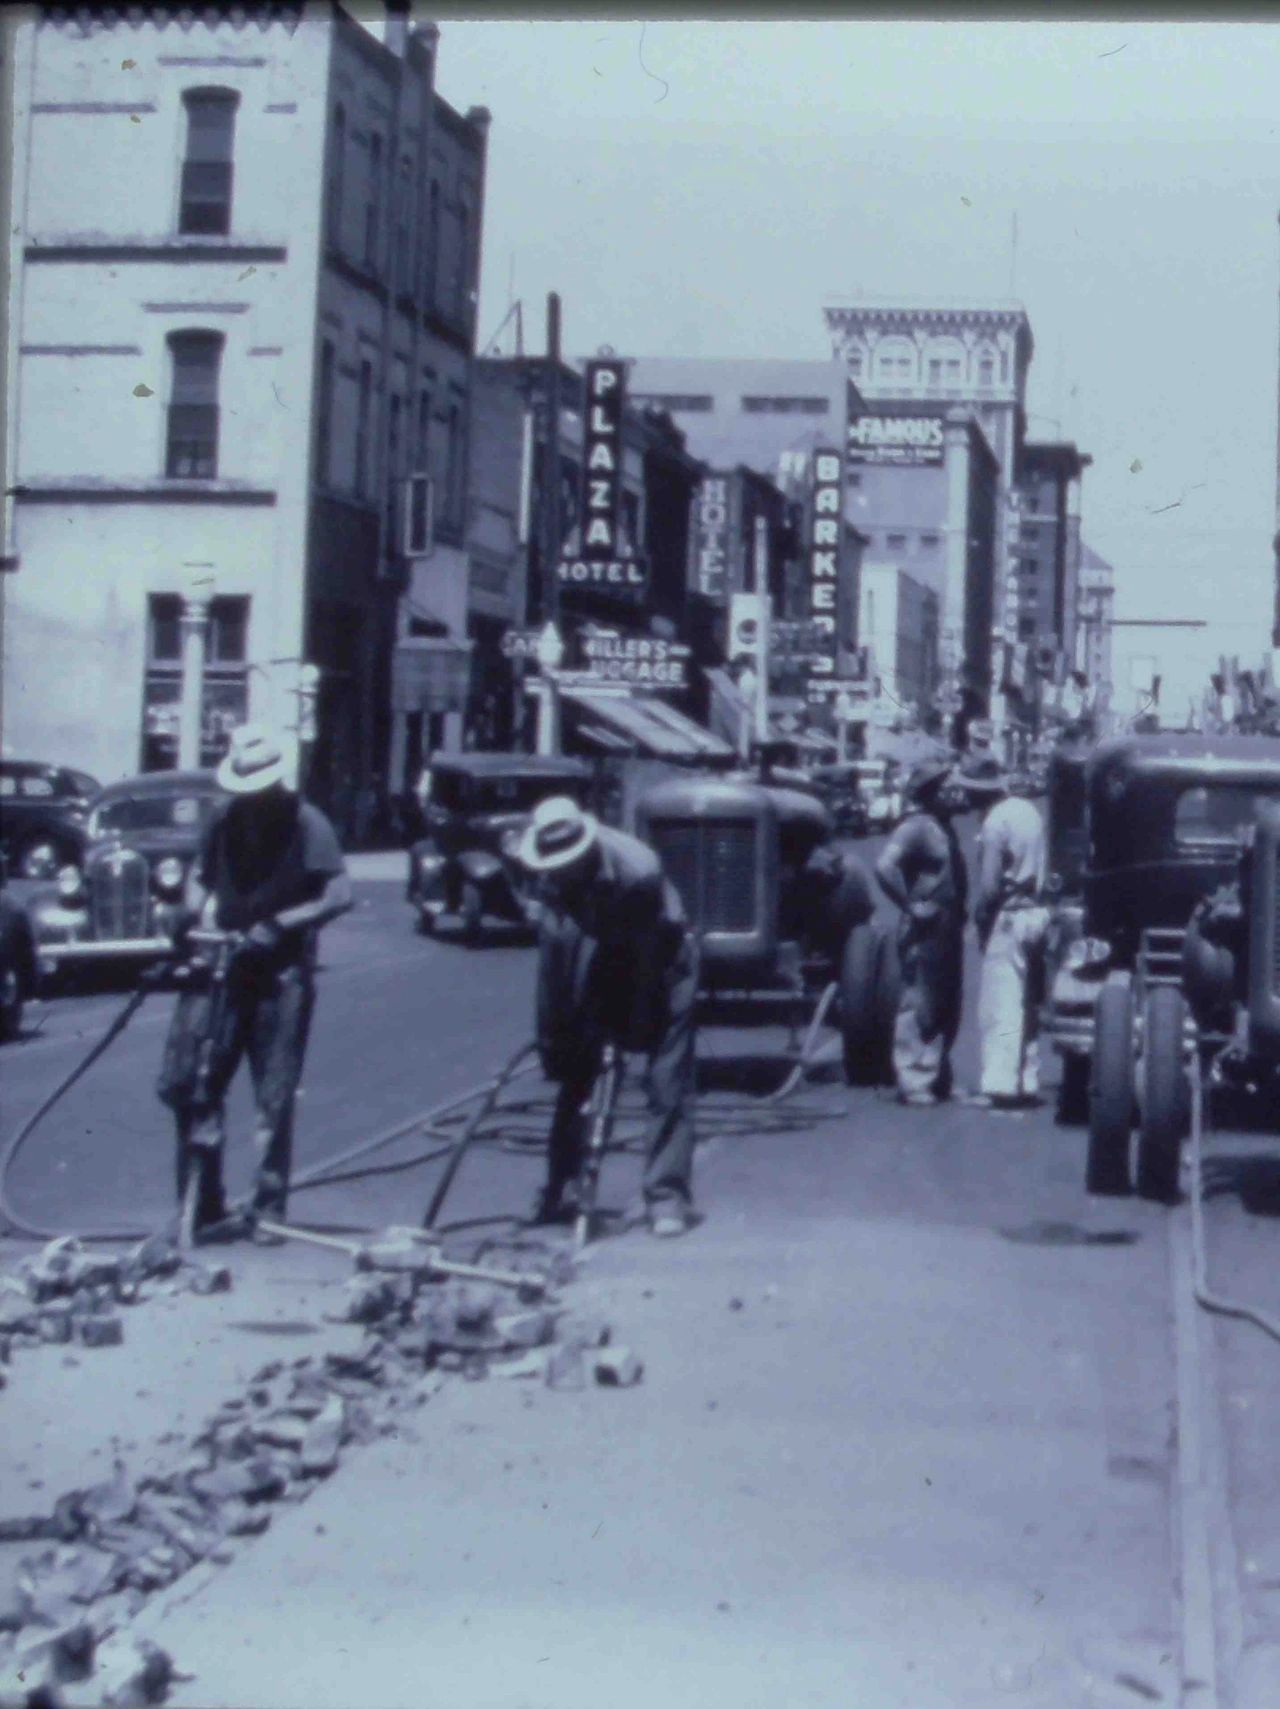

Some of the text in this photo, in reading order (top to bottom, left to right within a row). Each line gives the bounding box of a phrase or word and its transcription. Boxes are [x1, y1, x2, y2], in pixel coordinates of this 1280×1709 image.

[587, 368, 617, 545] PLAZA
[556, 561, 644, 583] HOTEL
[700, 479, 727, 596] HOTEL
